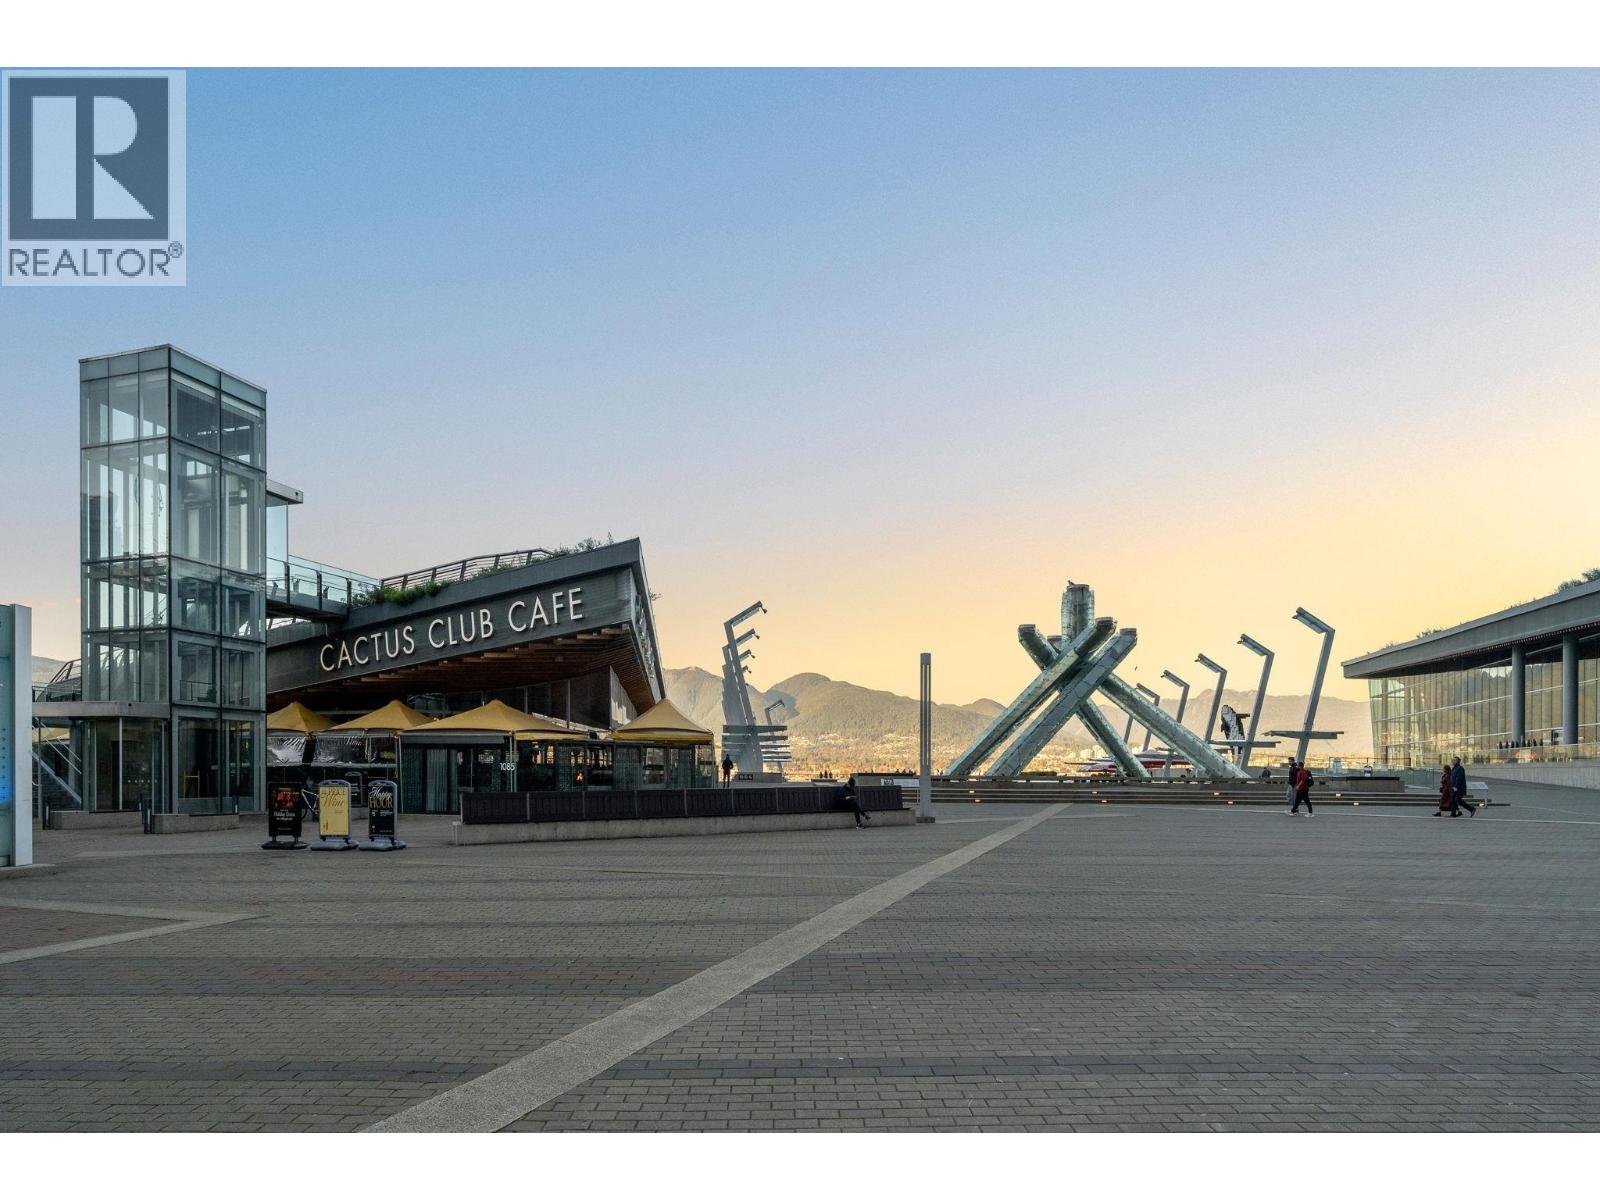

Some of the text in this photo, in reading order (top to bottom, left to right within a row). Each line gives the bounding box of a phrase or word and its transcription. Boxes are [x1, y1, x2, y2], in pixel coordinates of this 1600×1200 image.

[319, 587, 584, 672] CACTUS CLUB CAFE
[500, 762, 516, 771] 1085
[369, 797, 393, 809] HOUR
